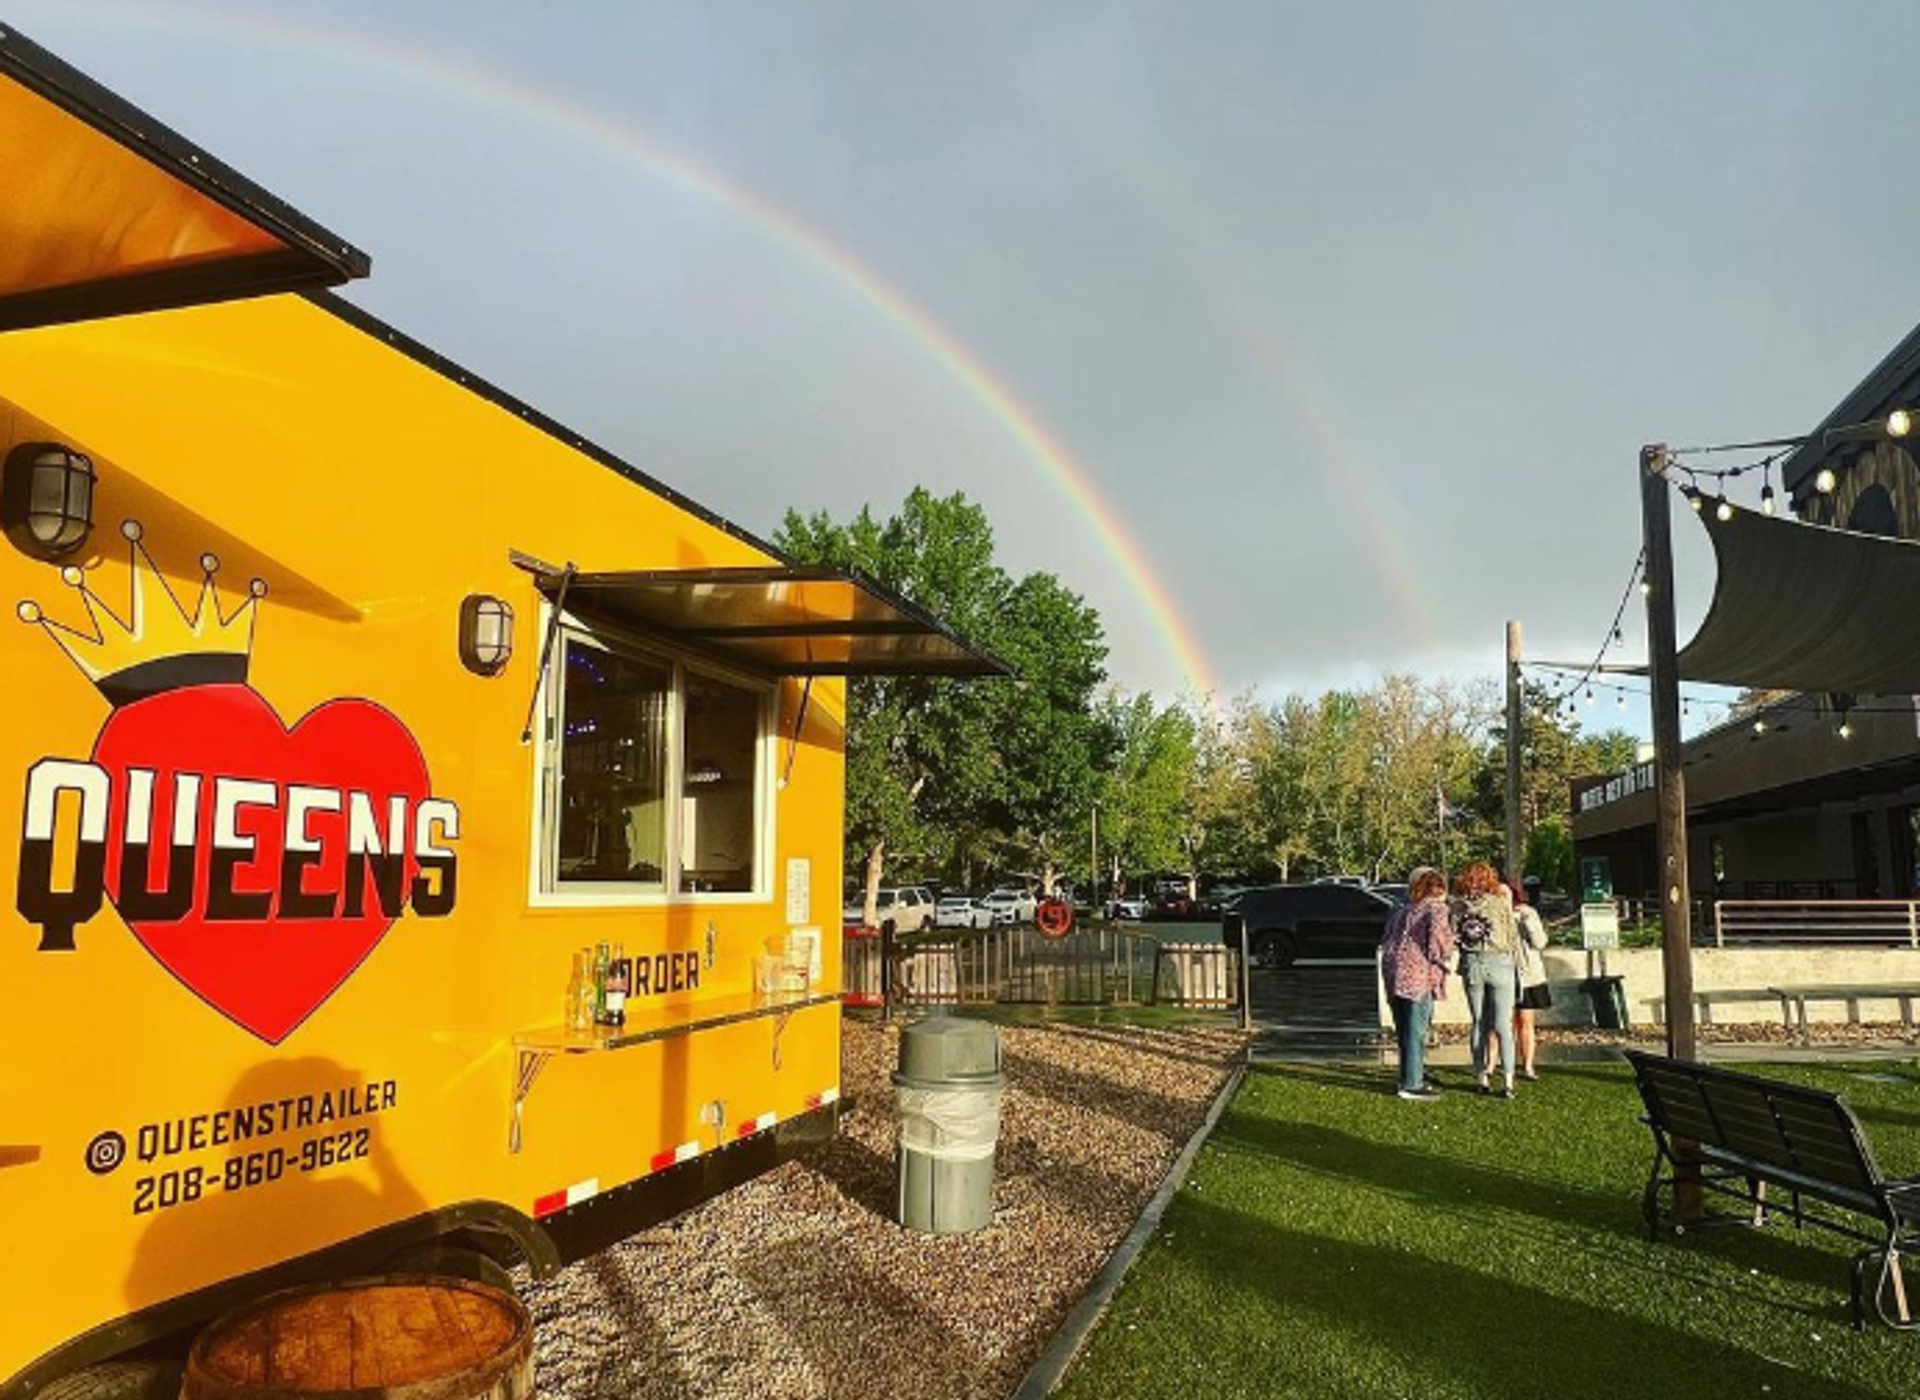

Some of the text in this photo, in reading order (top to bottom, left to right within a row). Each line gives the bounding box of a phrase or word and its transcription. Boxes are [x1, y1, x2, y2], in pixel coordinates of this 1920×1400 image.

[16, 757, 460, 951] QUEENS
[137, 1080, 397, 1162] QUEENSTRAILER
[133, 1128, 371, 1214] 208-860-9622
